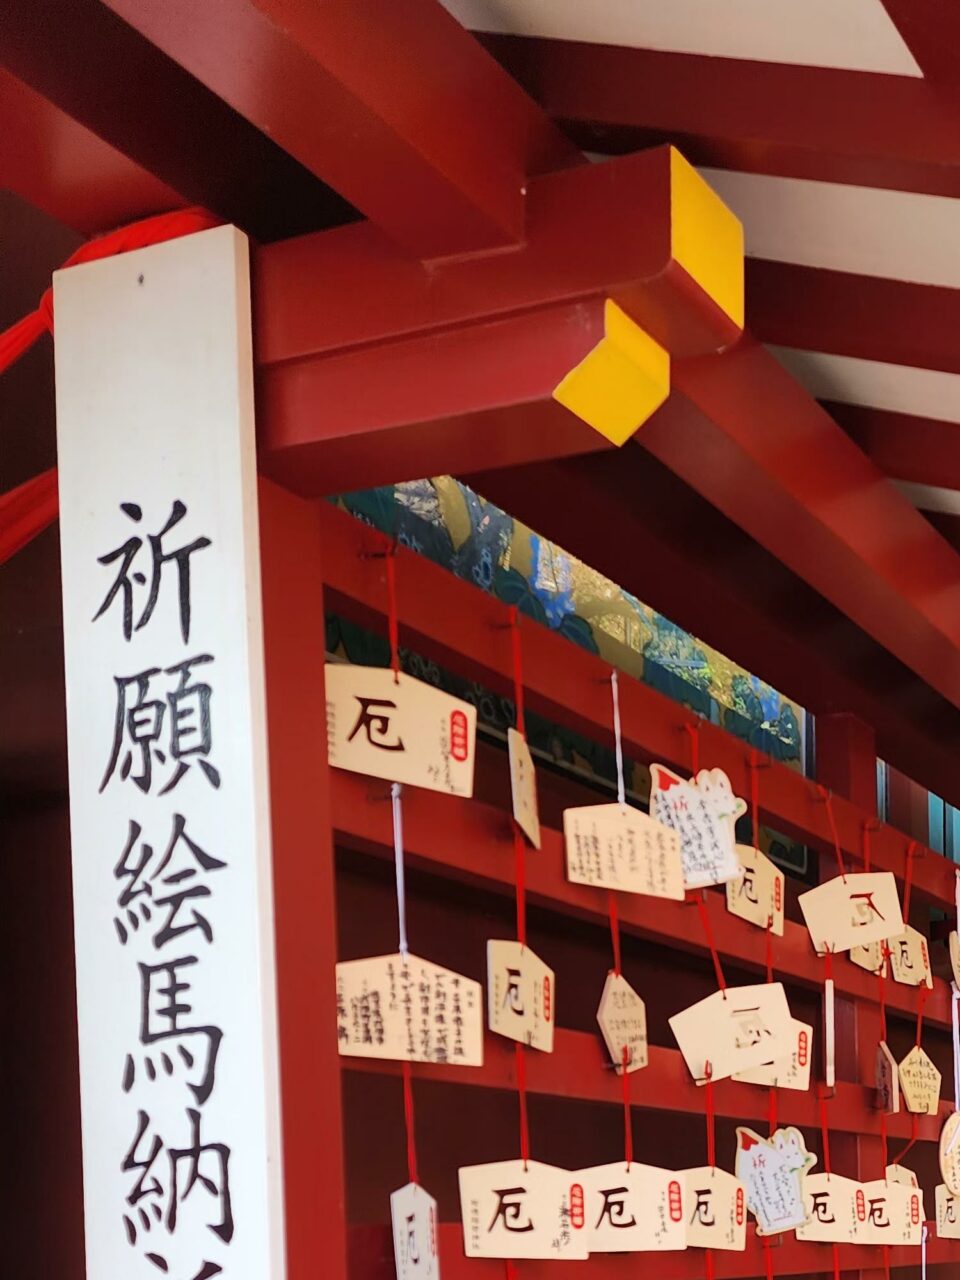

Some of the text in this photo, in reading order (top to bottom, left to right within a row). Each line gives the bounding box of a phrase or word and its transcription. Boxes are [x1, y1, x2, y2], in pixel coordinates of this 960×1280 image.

[347, 695, 405, 752] 厄
[739, 867, 759, 905] 厄
[898, 940, 914, 970] 厄
[502, 968, 525, 1017] 厄
[488, 1186, 535, 1234] 厄
[595, 1186, 637, 1230] 厄
[690, 1188, 716, 1227] 厄
[809, 1191, 836, 1224] 厄
[867, 1197, 891, 1228] 厄
